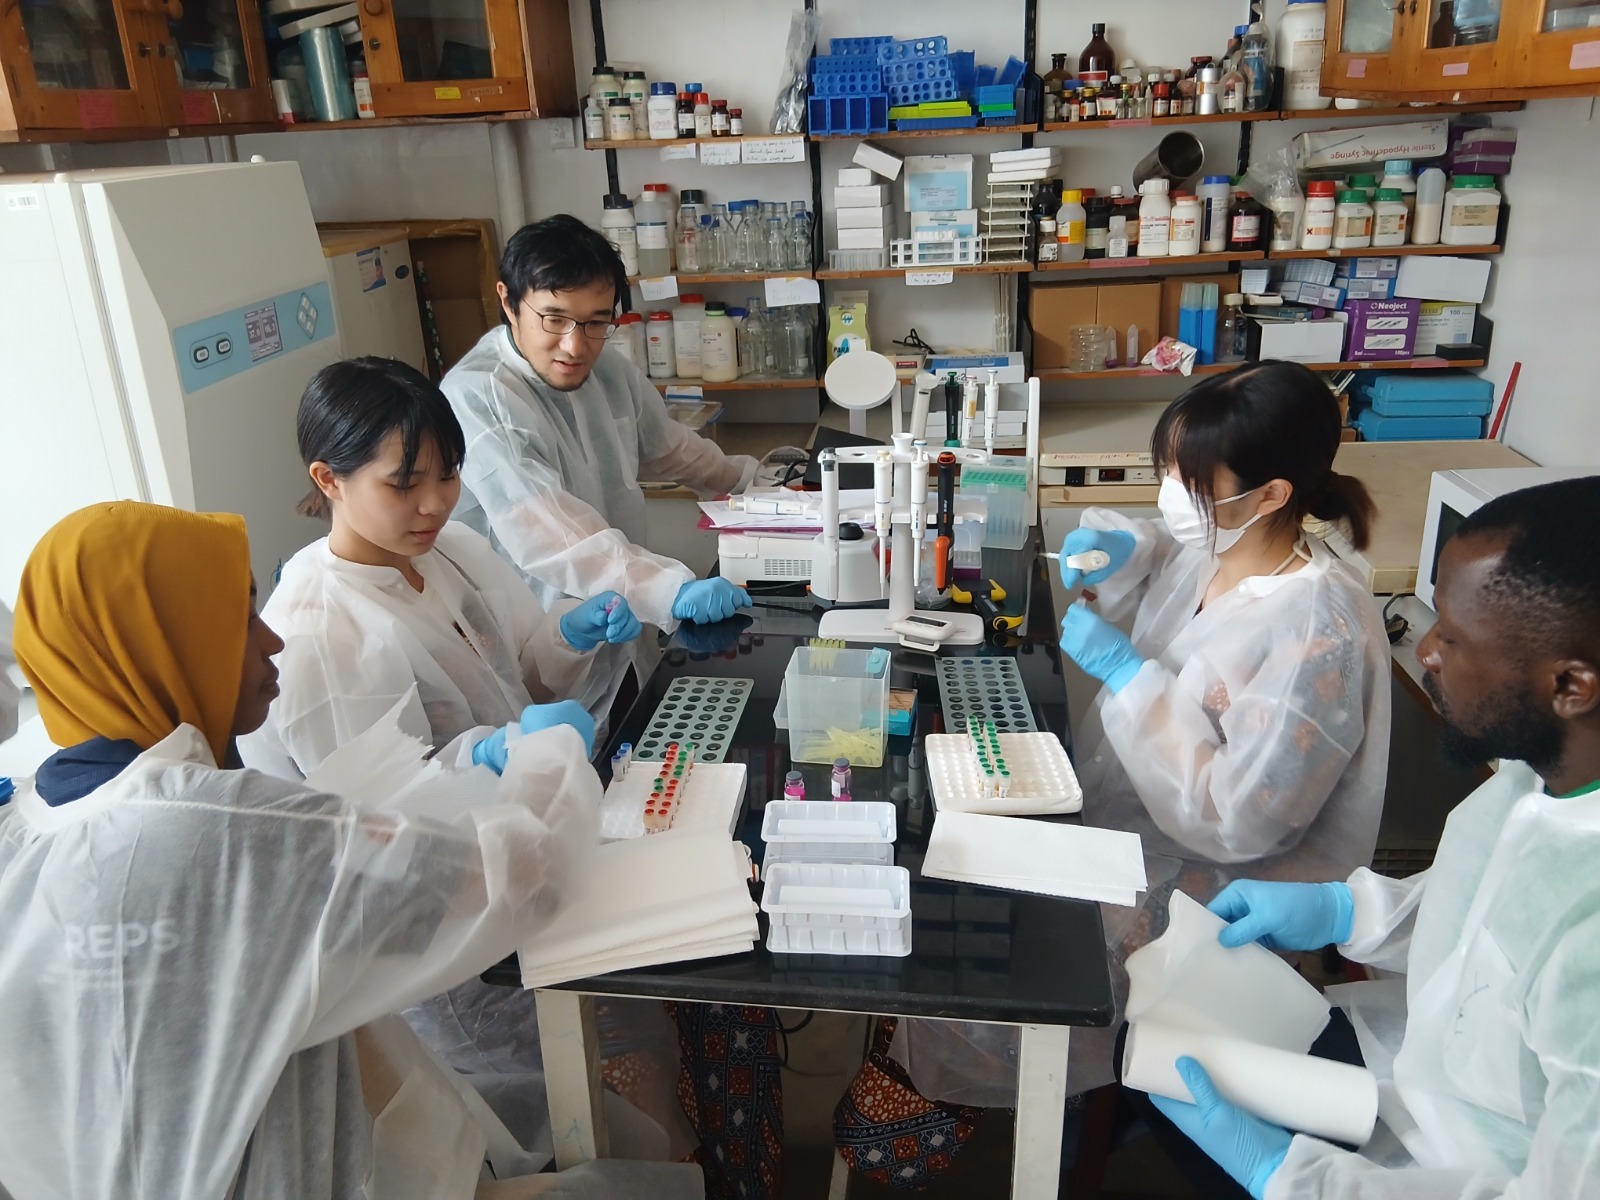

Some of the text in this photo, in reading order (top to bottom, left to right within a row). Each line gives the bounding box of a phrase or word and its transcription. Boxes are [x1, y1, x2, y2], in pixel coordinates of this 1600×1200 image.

[1330, 143, 1436, 160] Sterile Hypodermic Syringe
[1378, 302, 1407, 311] Neoject
[64, 918, 180, 959] REPS
